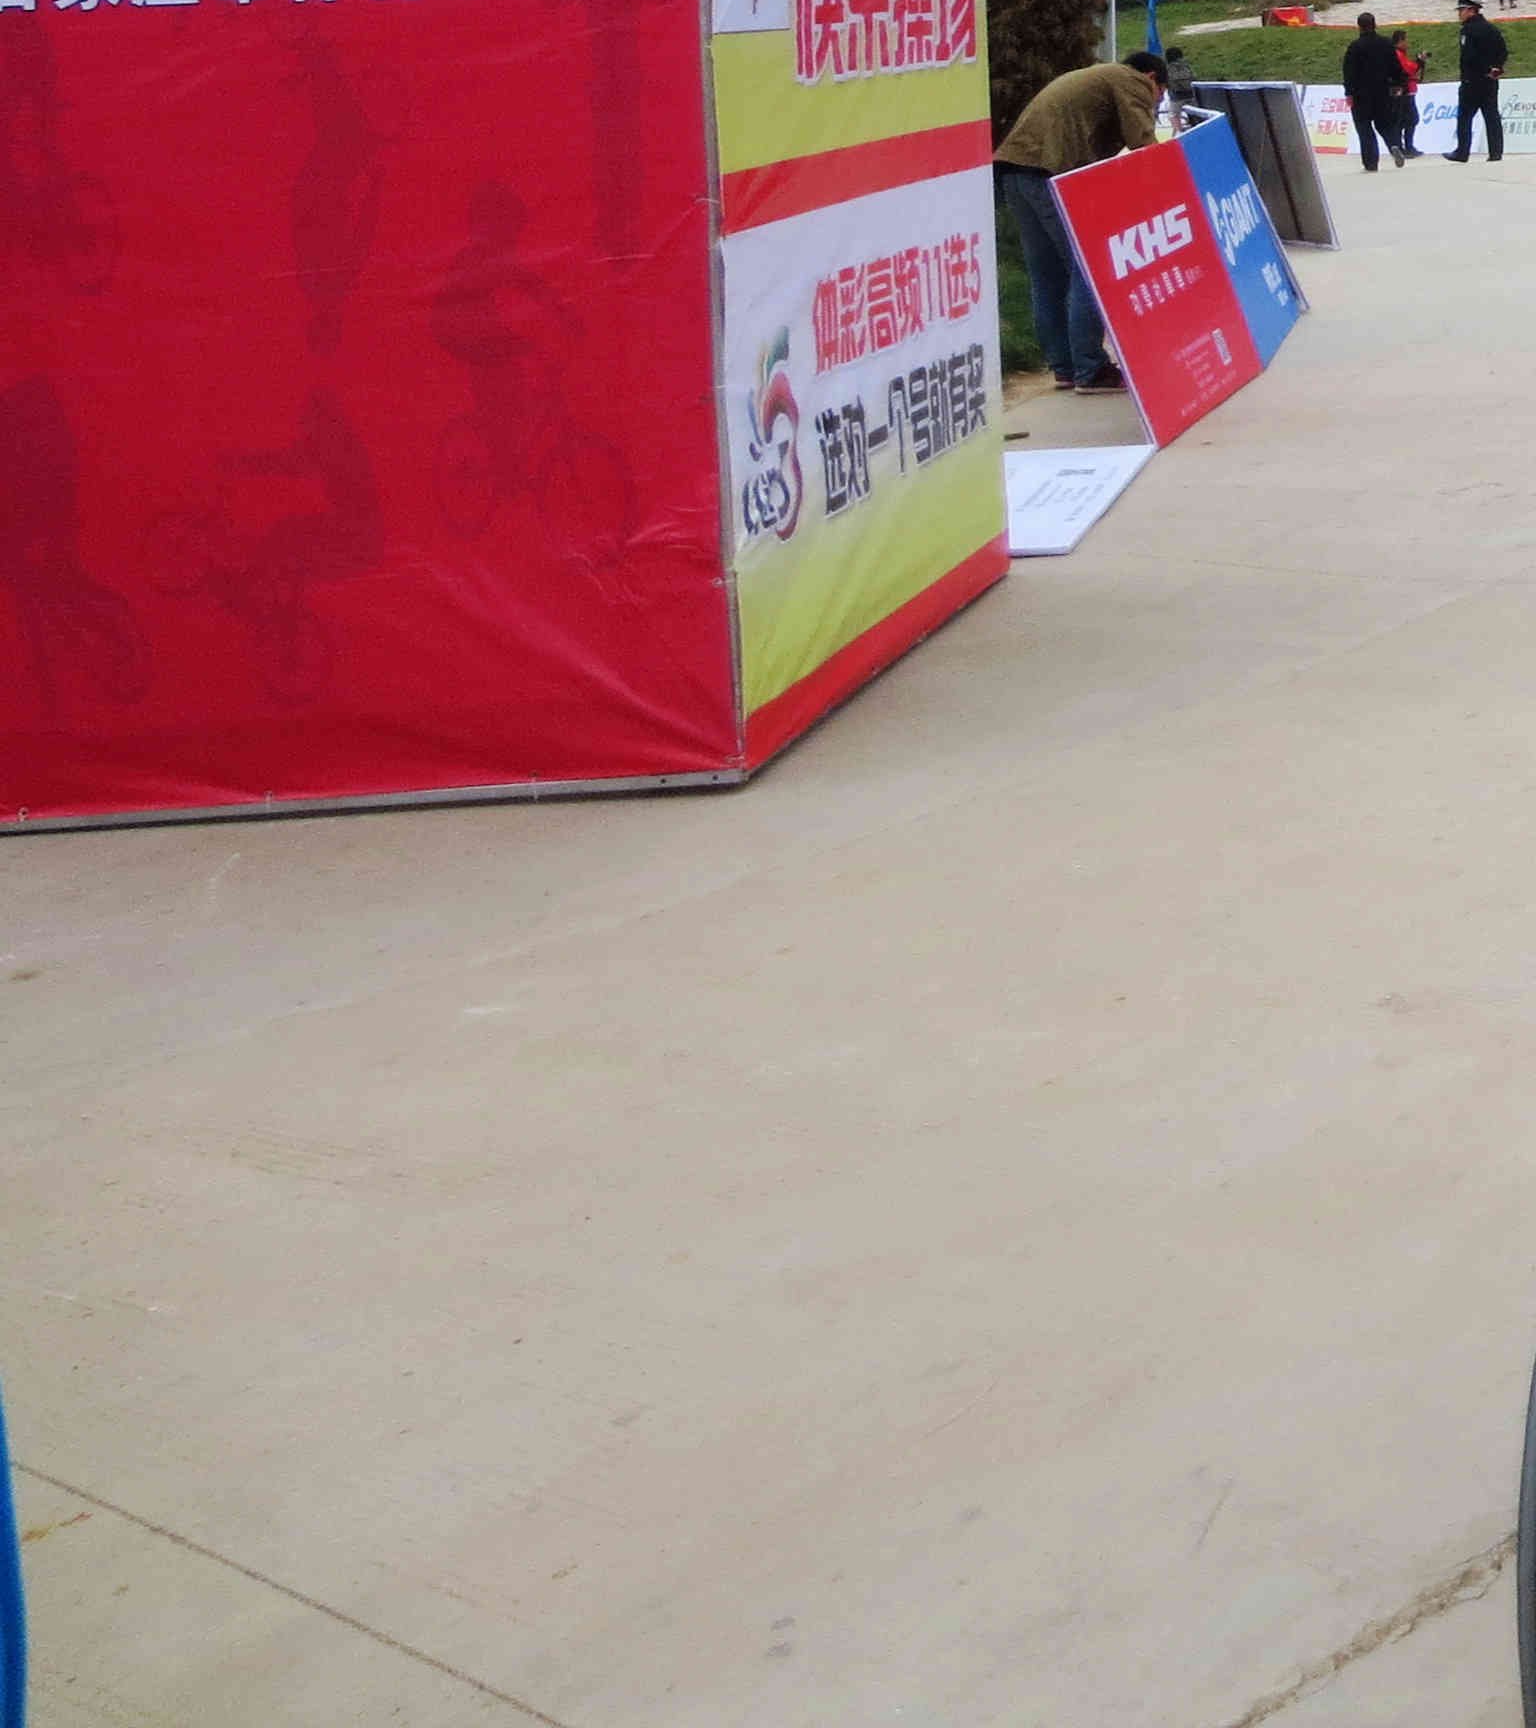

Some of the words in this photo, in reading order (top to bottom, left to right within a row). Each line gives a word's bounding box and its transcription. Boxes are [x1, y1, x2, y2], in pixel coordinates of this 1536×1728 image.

[1108, 203, 1193, 281] KHS
[812, 231, 981, 376] 体彩高频11选5
